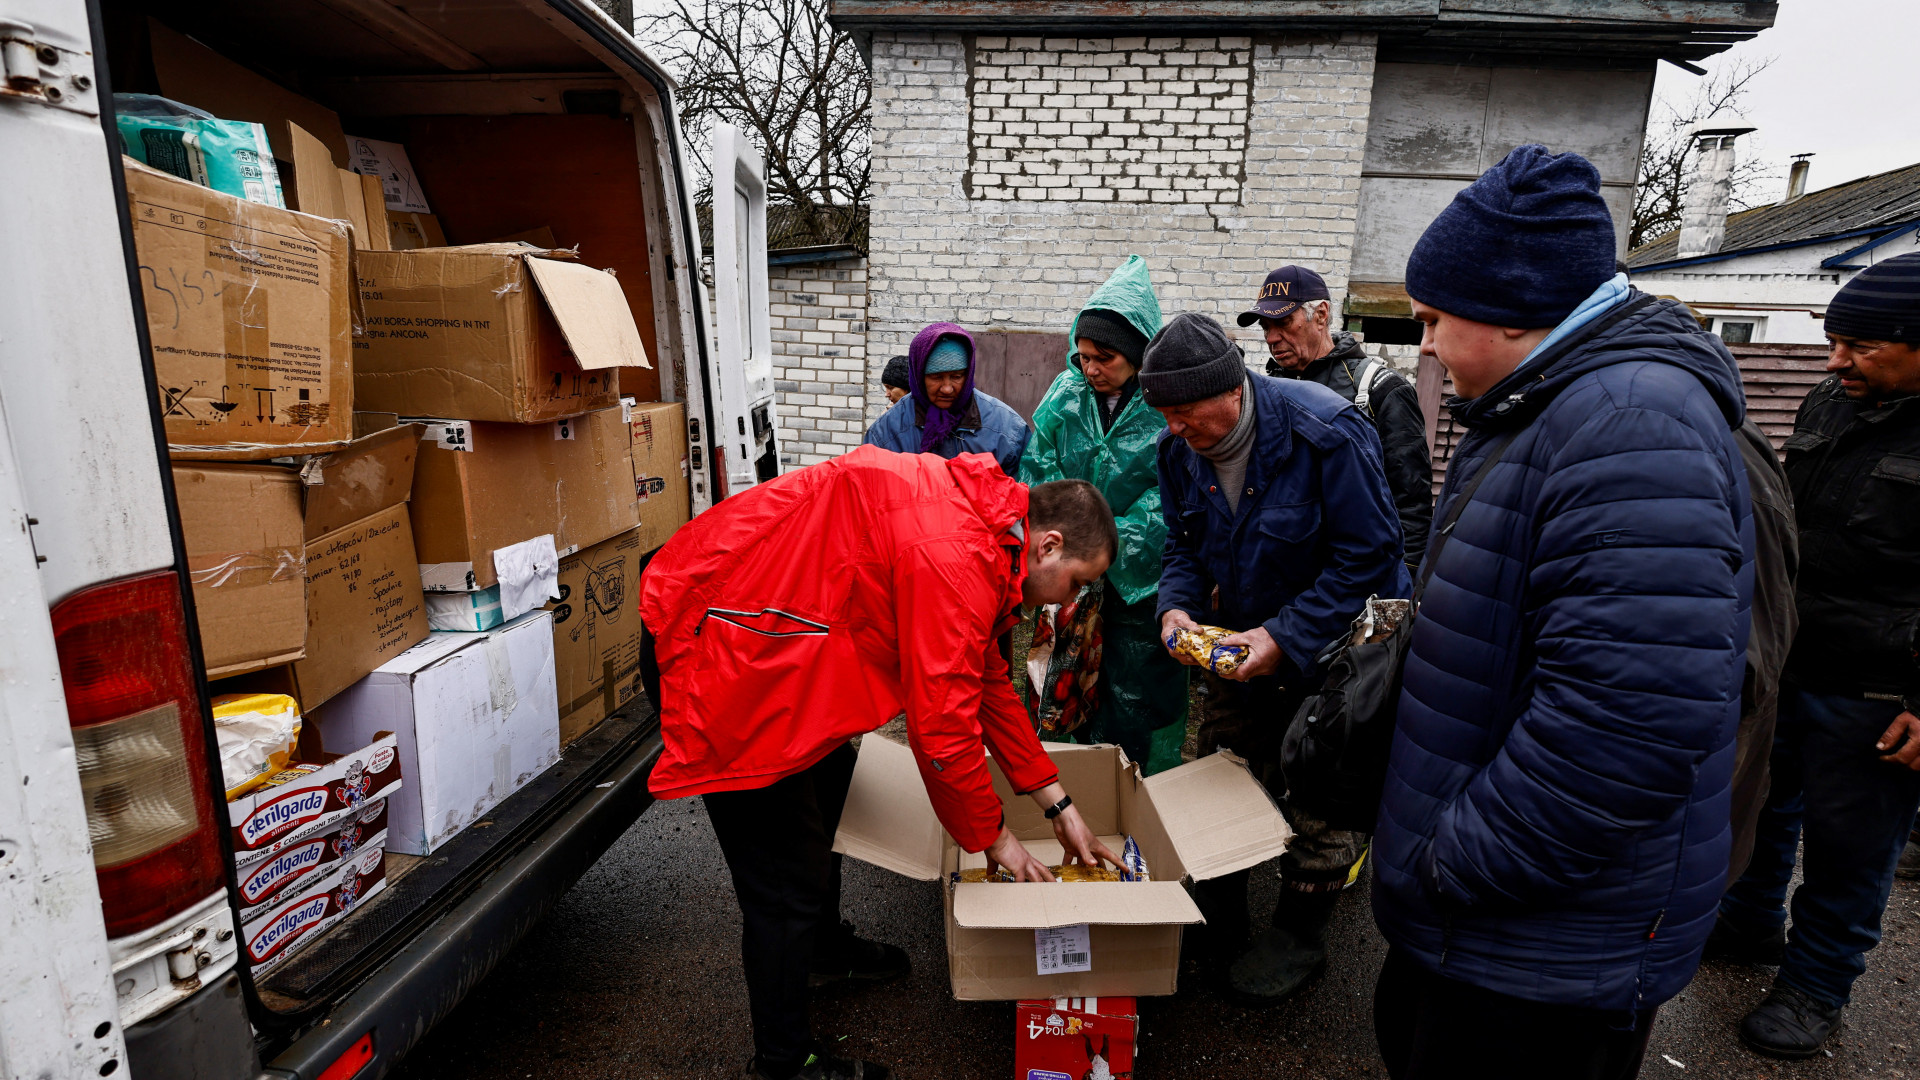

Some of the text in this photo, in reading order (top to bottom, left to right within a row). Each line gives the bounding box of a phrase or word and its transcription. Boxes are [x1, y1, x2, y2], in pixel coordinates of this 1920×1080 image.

[279, 240, 296, 250] China
[302, 245, 318, 255] Made
[1263, 302, 1296, 316] VALENTINO
[384, 317, 414, 327] BORSA
[415, 317, 461, 328] SHOPPING
[463, 319, 473, 329] IN
[474, 320, 491, 330] TNT
[389, 329, 430, 339] ANCONA
[246, 792, 323, 838] sterilgarda
[270, 818, 300, 837] alimenti
[272, 841, 282, 852] 8
[283, 820, 326, 846] CONFEZIONI
[327, 812, 342, 824] TRIS
[248, 843, 320, 895] sterilgarda
[272, 870, 299, 889] alimenti
[272, 892, 281, 903] 8
[281, 871, 320, 898] CONFEZIONI
[255, 900, 324, 954] sterilgarda
[278, 949, 287, 960] 8
[1026, 1020, 1045, 1040] 4
[1044, 1025, 1065, 1036] 104
